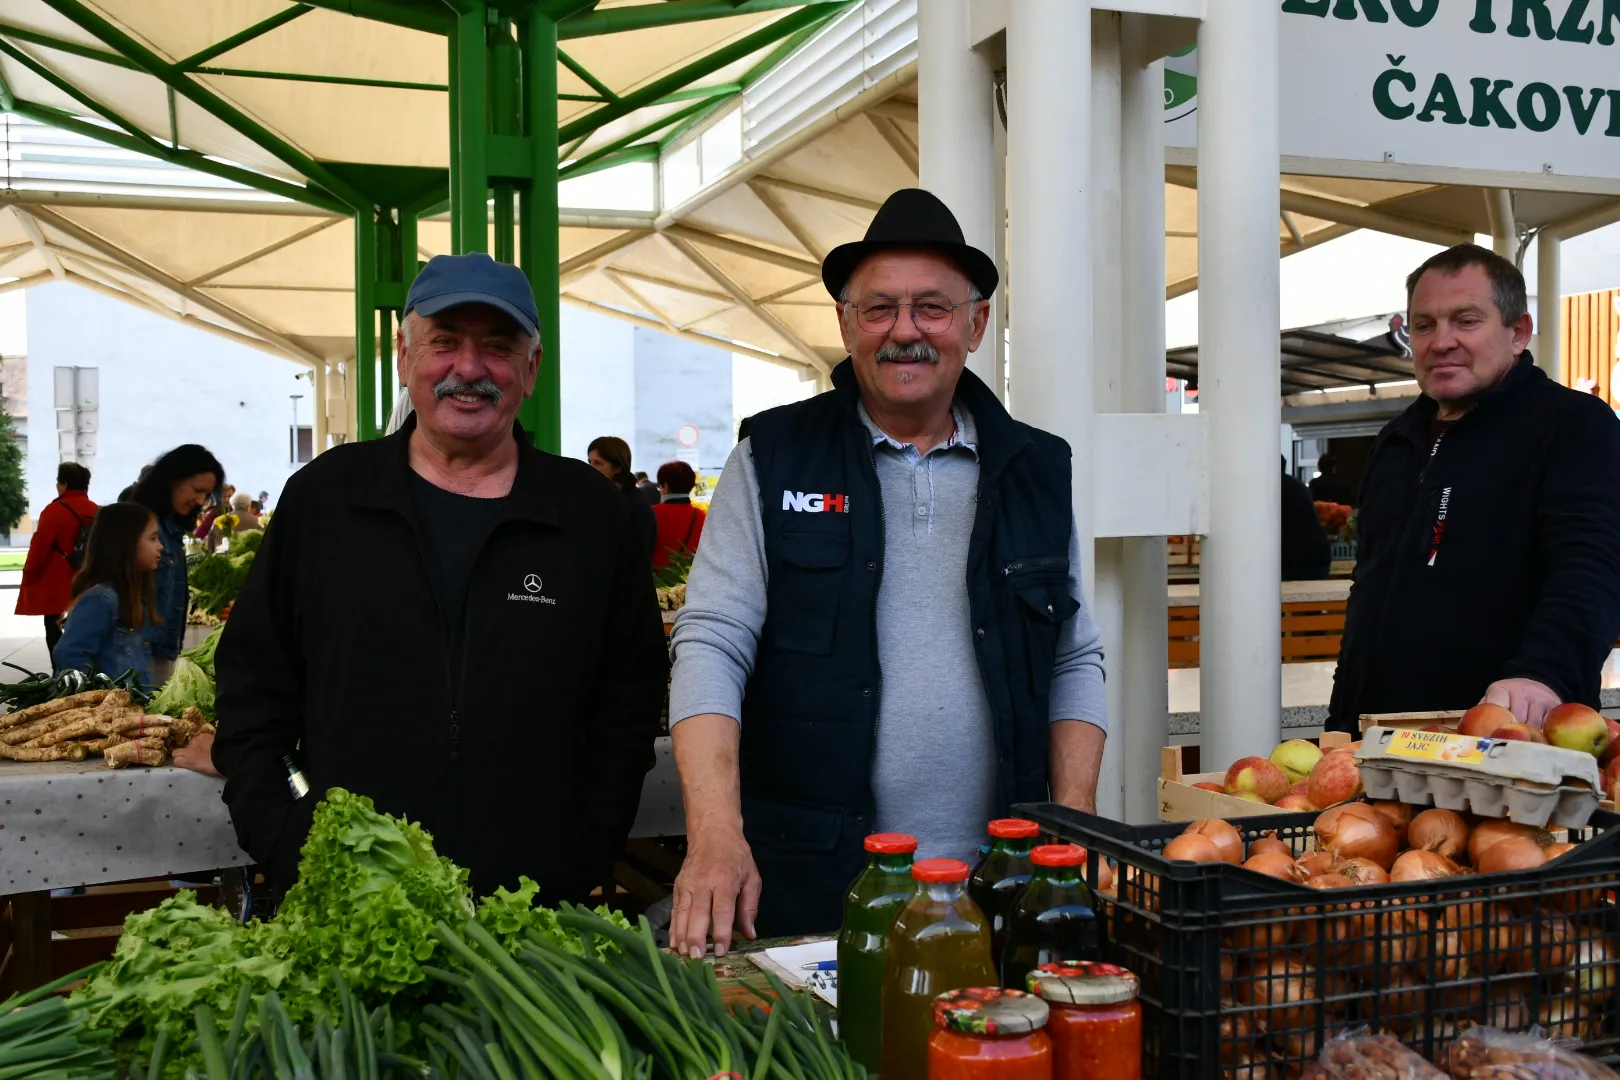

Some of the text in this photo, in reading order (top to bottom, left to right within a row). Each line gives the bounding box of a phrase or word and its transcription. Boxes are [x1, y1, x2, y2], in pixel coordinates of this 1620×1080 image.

[782, 489, 844, 513] NGH
[1438, 487, 1452, 520] WIGHTS
[507, 593, 556, 605] Mercedes-Benz
